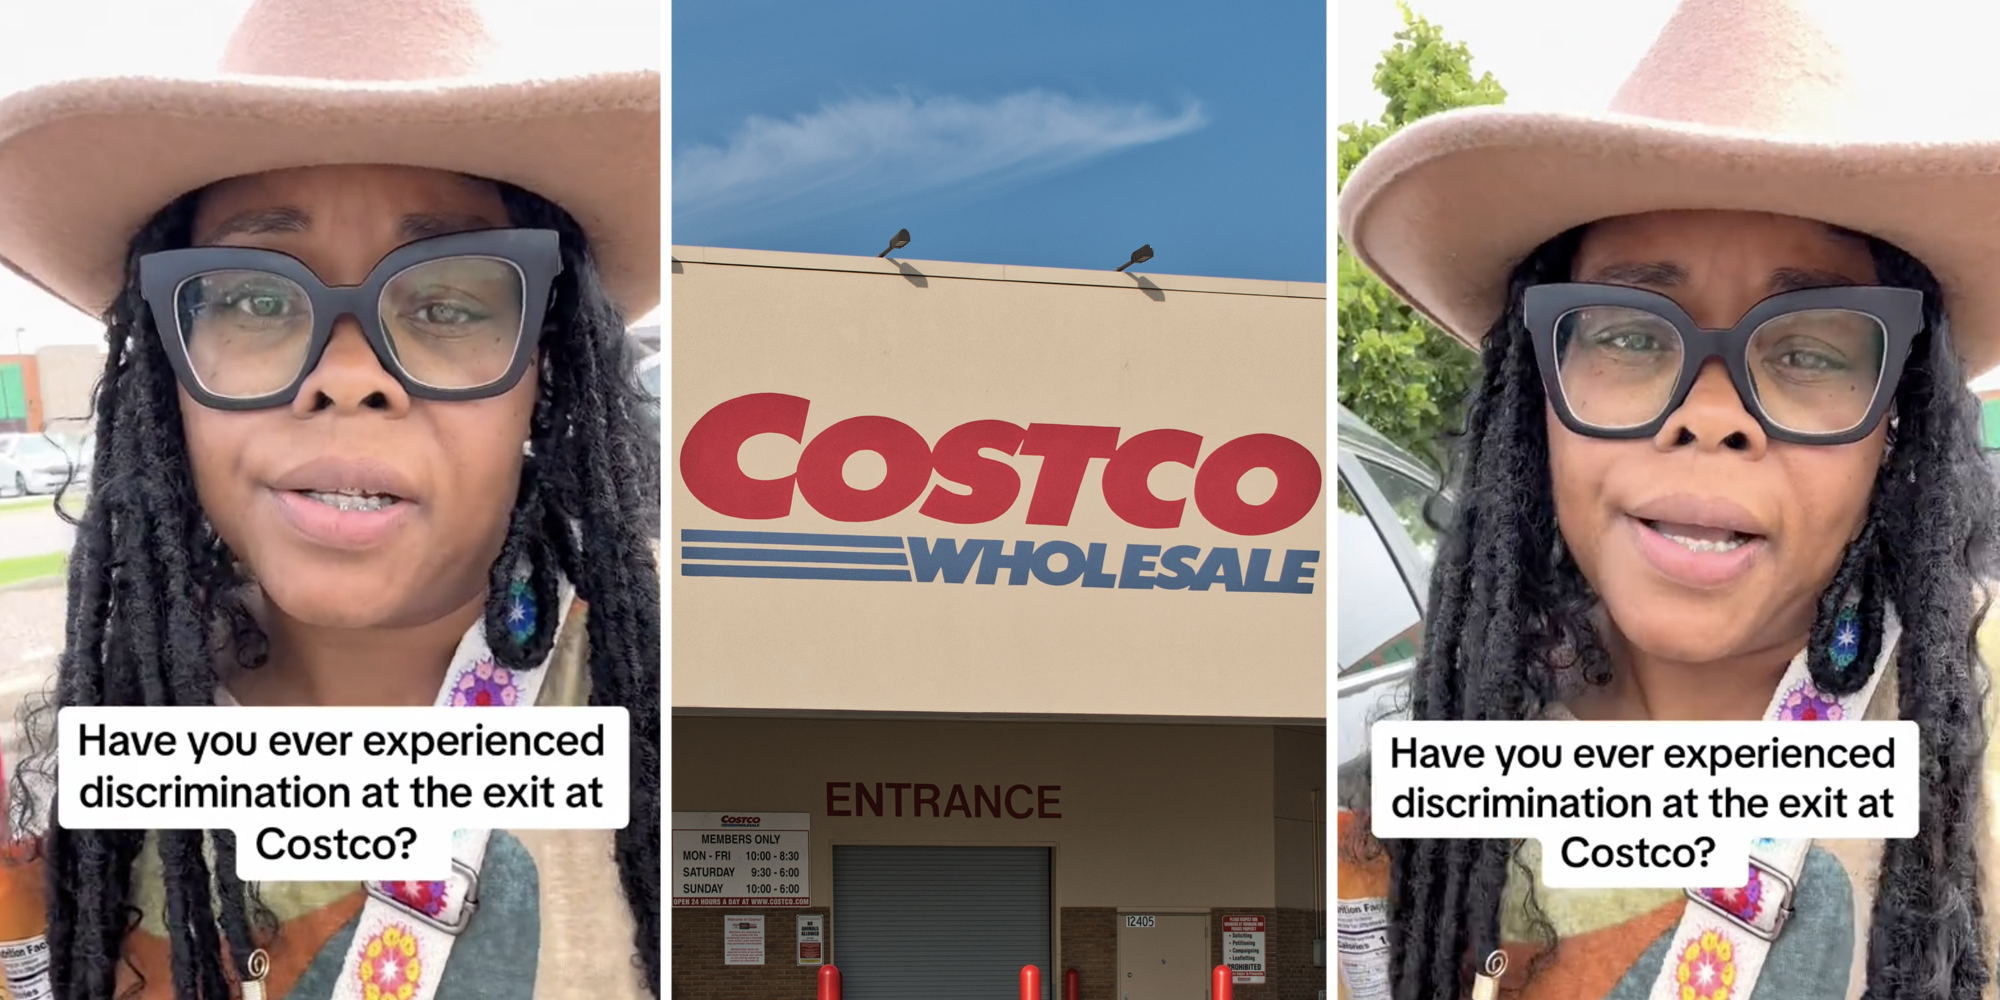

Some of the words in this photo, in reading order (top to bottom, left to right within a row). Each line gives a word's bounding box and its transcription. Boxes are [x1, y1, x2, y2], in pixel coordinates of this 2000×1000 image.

[680, 392, 1322, 536] COSTCO
[907, 537, 1320, 594] WHOLESALE
[826, 782, 1062, 819] ENTRANCE
[721, 815, 761, 824] COSTCO
[701, 834, 752, 845] MEMBERS
[754, 834, 781, 845] ONLY
[682, 850, 706, 861] MON
[714, 850, 731, 861] FRI
[745, 851, 772, 861] 10:00
[779, 851, 800, 861] 8:30
[682, 867, 736, 878] SATURDAY
[751, 867, 772, 878] 9:30
[779, 867, 800, 878] 6:00
[682, 883, 724, 894] SUNDAY
[746, 883, 772, 894] 10:00
[779, 883, 800, 894] 6:00
[673, 898, 690, 906] OPEN
[691, 898, 699, 906] 24
[700, 898, 721, 906] HOURS
[722, 898, 727, 906] A
[728, 898, 740, 906] DAY
[742, 898, 749, 906] AT
[751, 898, 809, 906] WWW.COSTCO.COM
[1127, 916, 1154, 927] 12405
